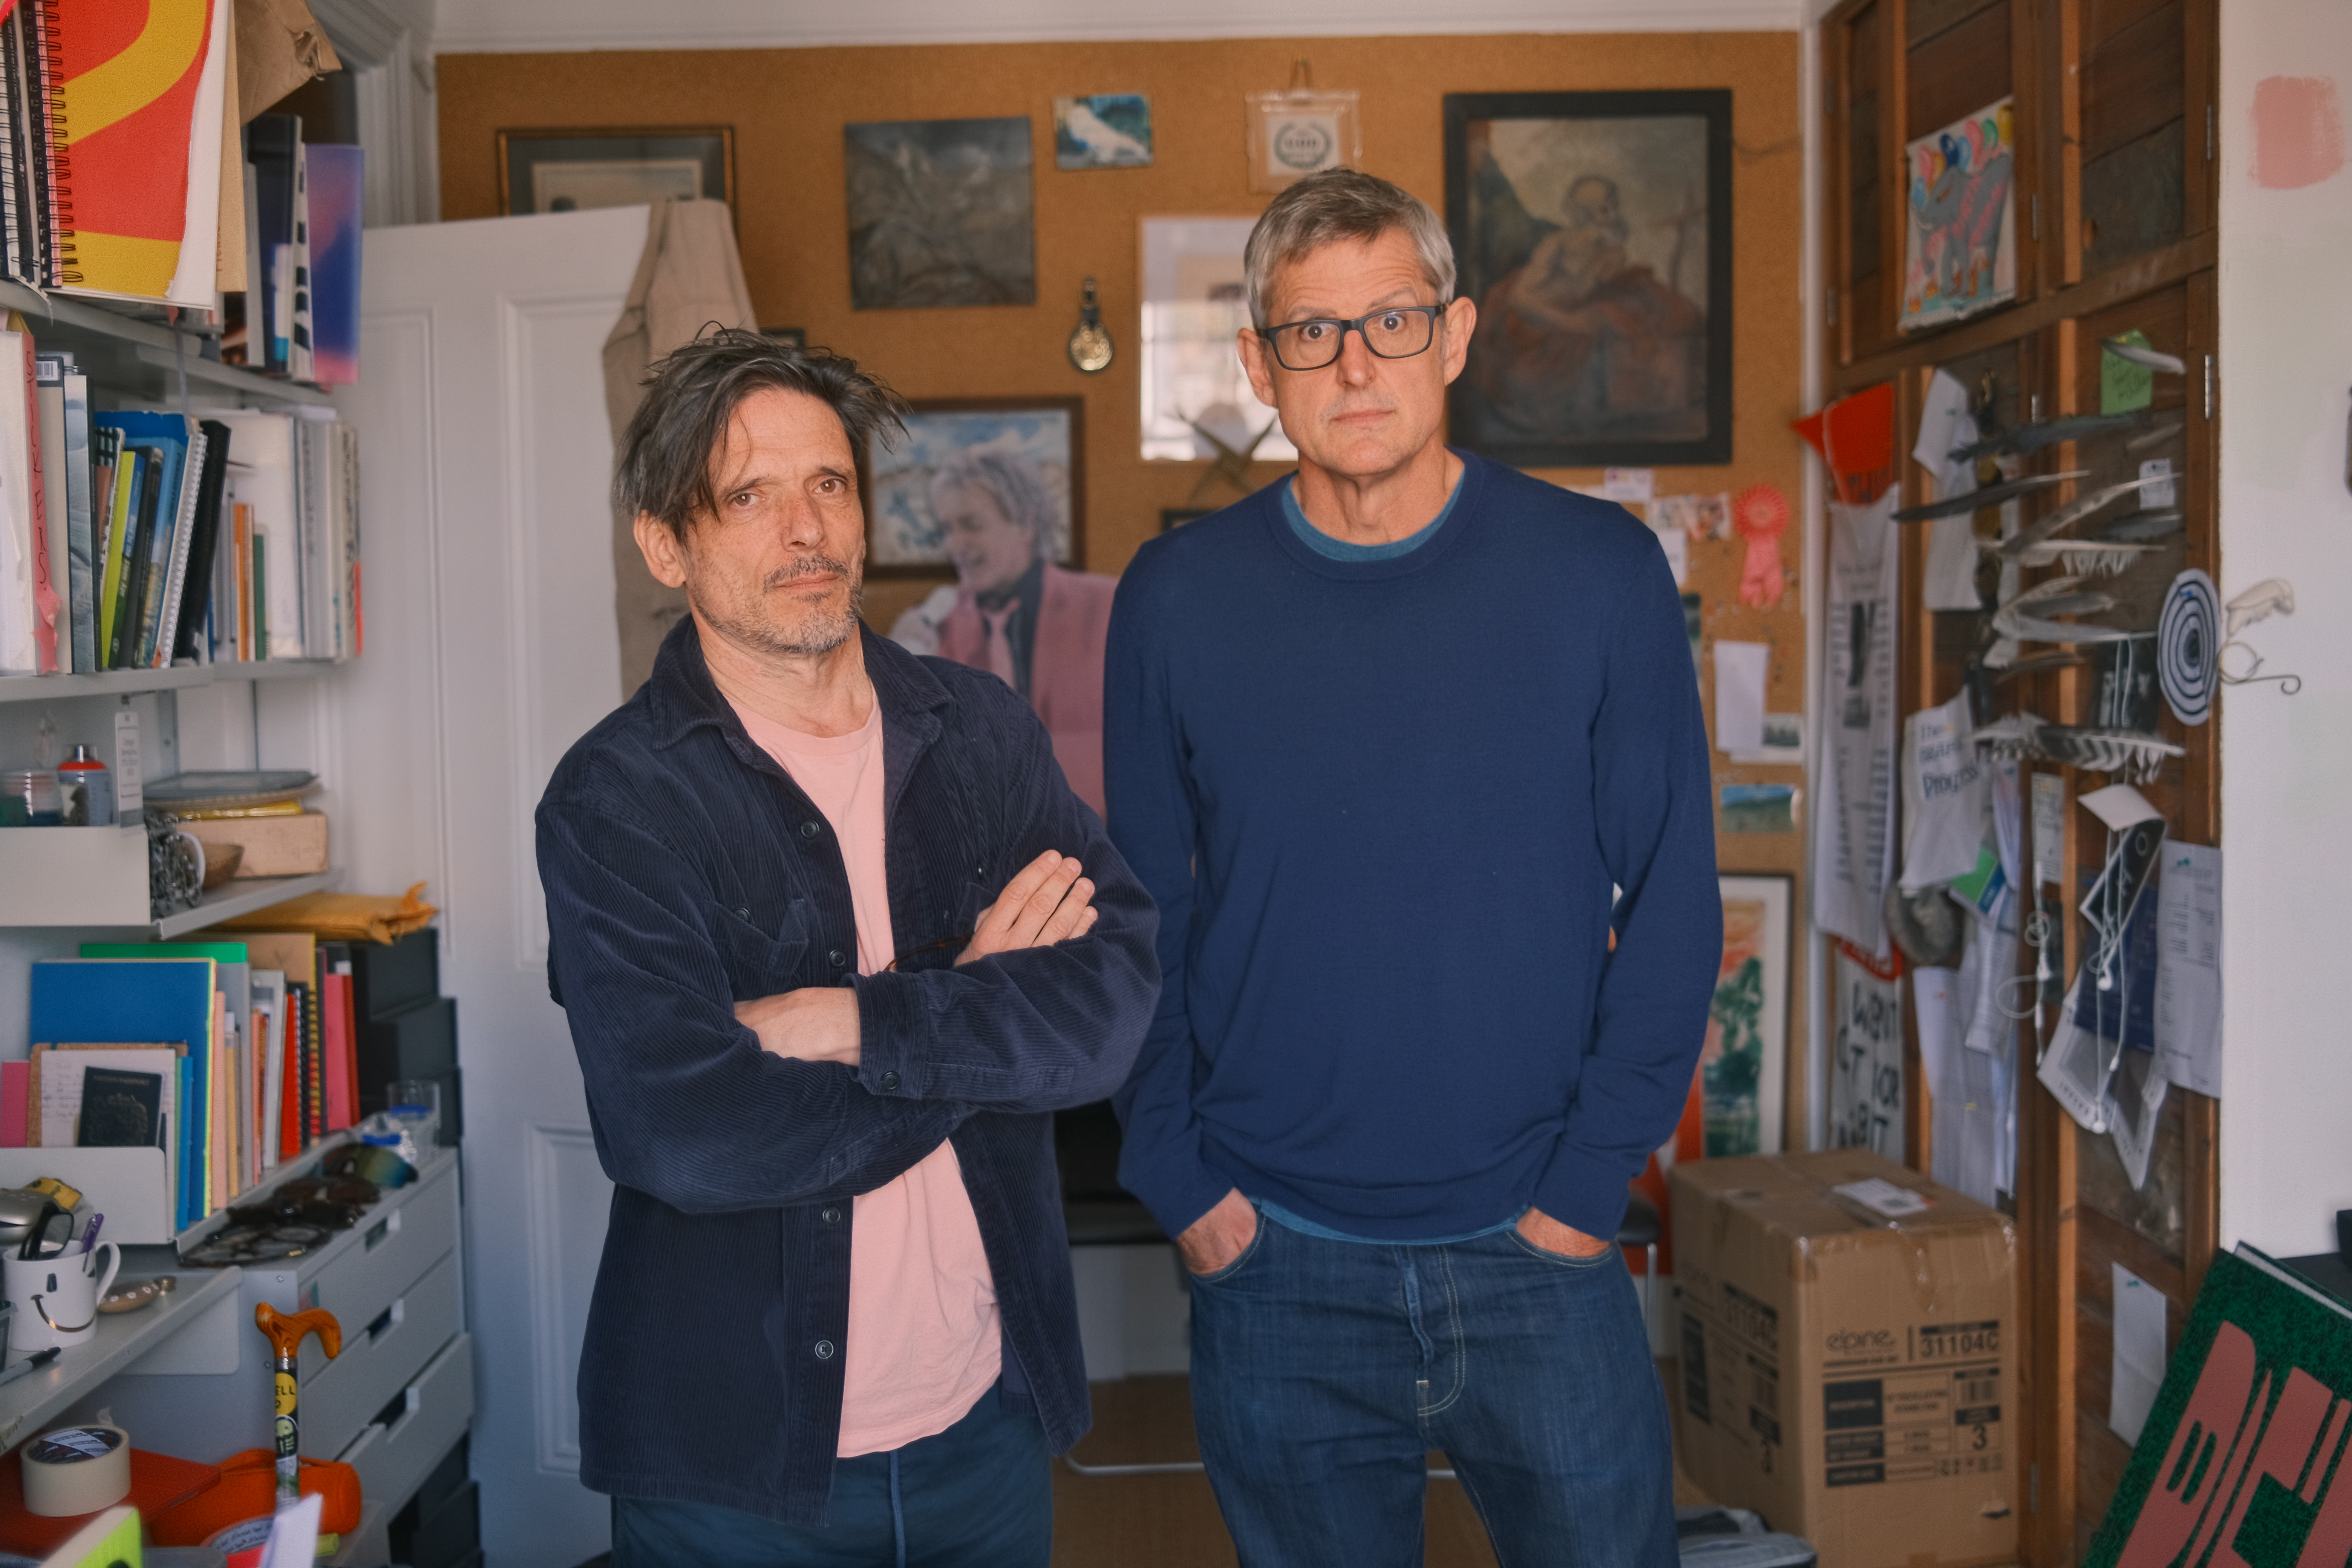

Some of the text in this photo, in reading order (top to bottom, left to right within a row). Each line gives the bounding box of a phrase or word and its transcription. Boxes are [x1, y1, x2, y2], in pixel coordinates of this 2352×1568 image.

[26, 350, 47, 591] STICKERS.
[1920, 1331, 1999, 1358] 31104C
[1972, 1426, 1988, 1450] 3
